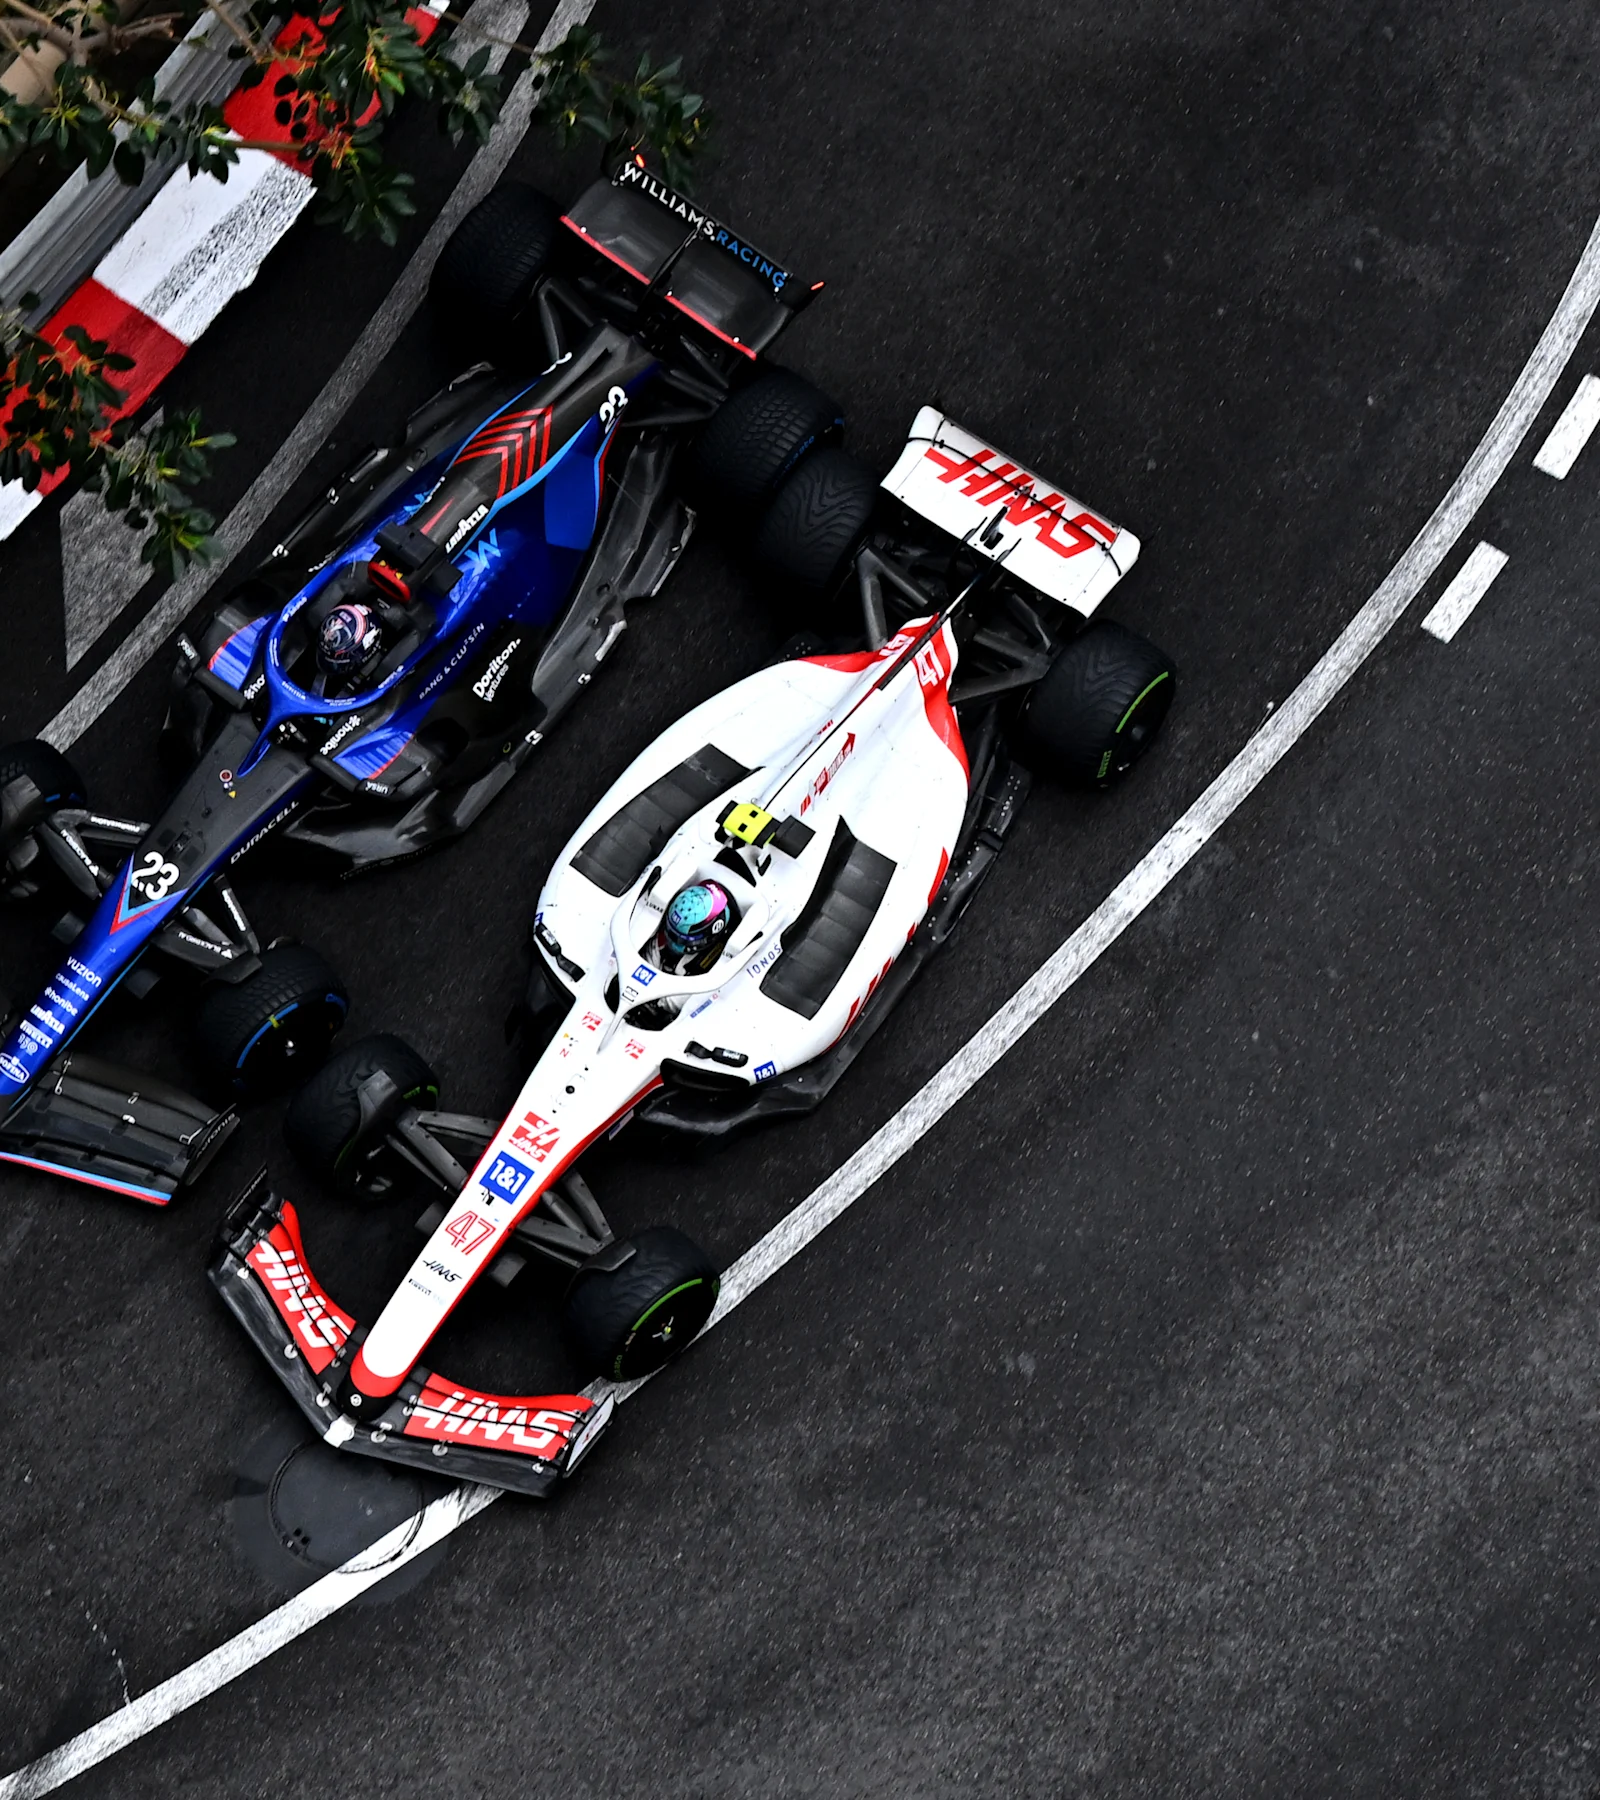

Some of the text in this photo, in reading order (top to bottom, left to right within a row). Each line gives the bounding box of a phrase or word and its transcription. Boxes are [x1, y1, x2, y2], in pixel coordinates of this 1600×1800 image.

[622, 160, 787, 288] WILLIAMS RACING
[599, 385, 629, 434] 23
[923, 447, 1117, 559] HAAS
[483, 662, 510, 703] Ventures
[914, 640, 945, 687] 47
[230, 800, 300, 865] DURACELL
[130, 850, 181, 901] 23
[746, 943, 782, 979] IONOS
[755, 1064, 777, 1081] 1&1
[488, 1158, 528, 1195] 1&1
[445, 1210, 497, 1256] 47
[255, 1239, 352, 1349] HAAS
[422, 1259, 463, 1283] HAAS
[411, 1390, 578, 1450] HAAS
